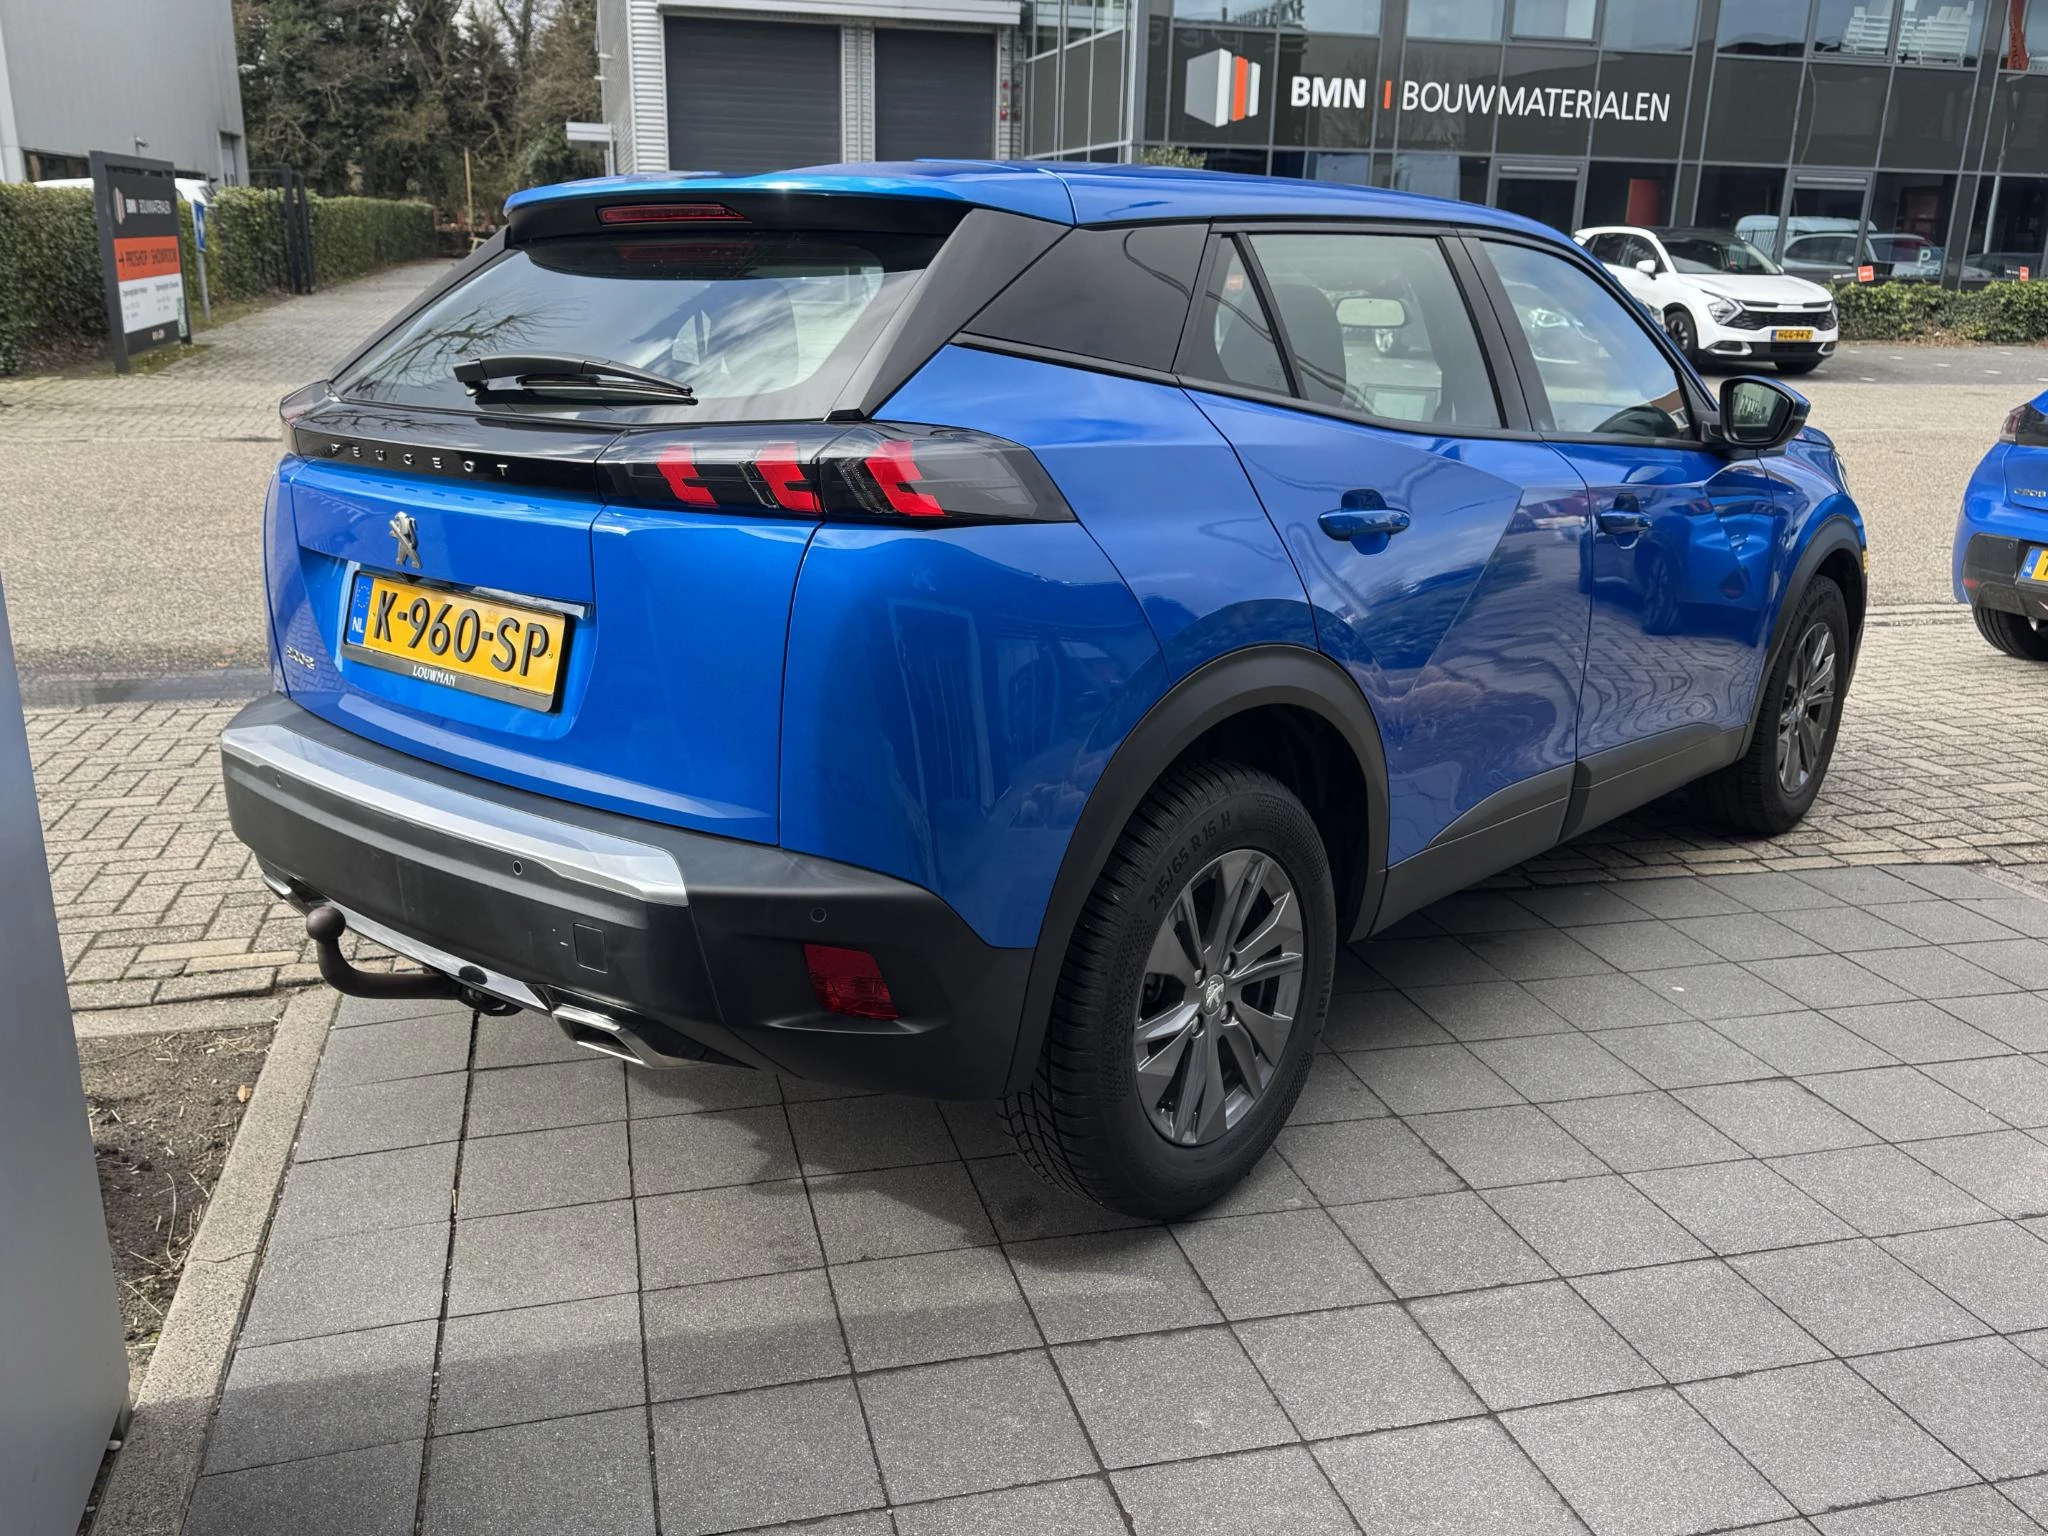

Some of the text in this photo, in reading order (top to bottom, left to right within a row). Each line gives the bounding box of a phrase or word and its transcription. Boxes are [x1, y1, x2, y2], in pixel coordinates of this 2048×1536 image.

[1291, 76, 1671, 122] BMN BOUWMATERIALEN
[331, 443, 508, 476] PEUGEOT
[351, 590, 549, 676] NL K-960-SP
[412, 664, 456, 687] LOUWMAN
[1148, 810, 1231, 912] 215/65 R 16 H
